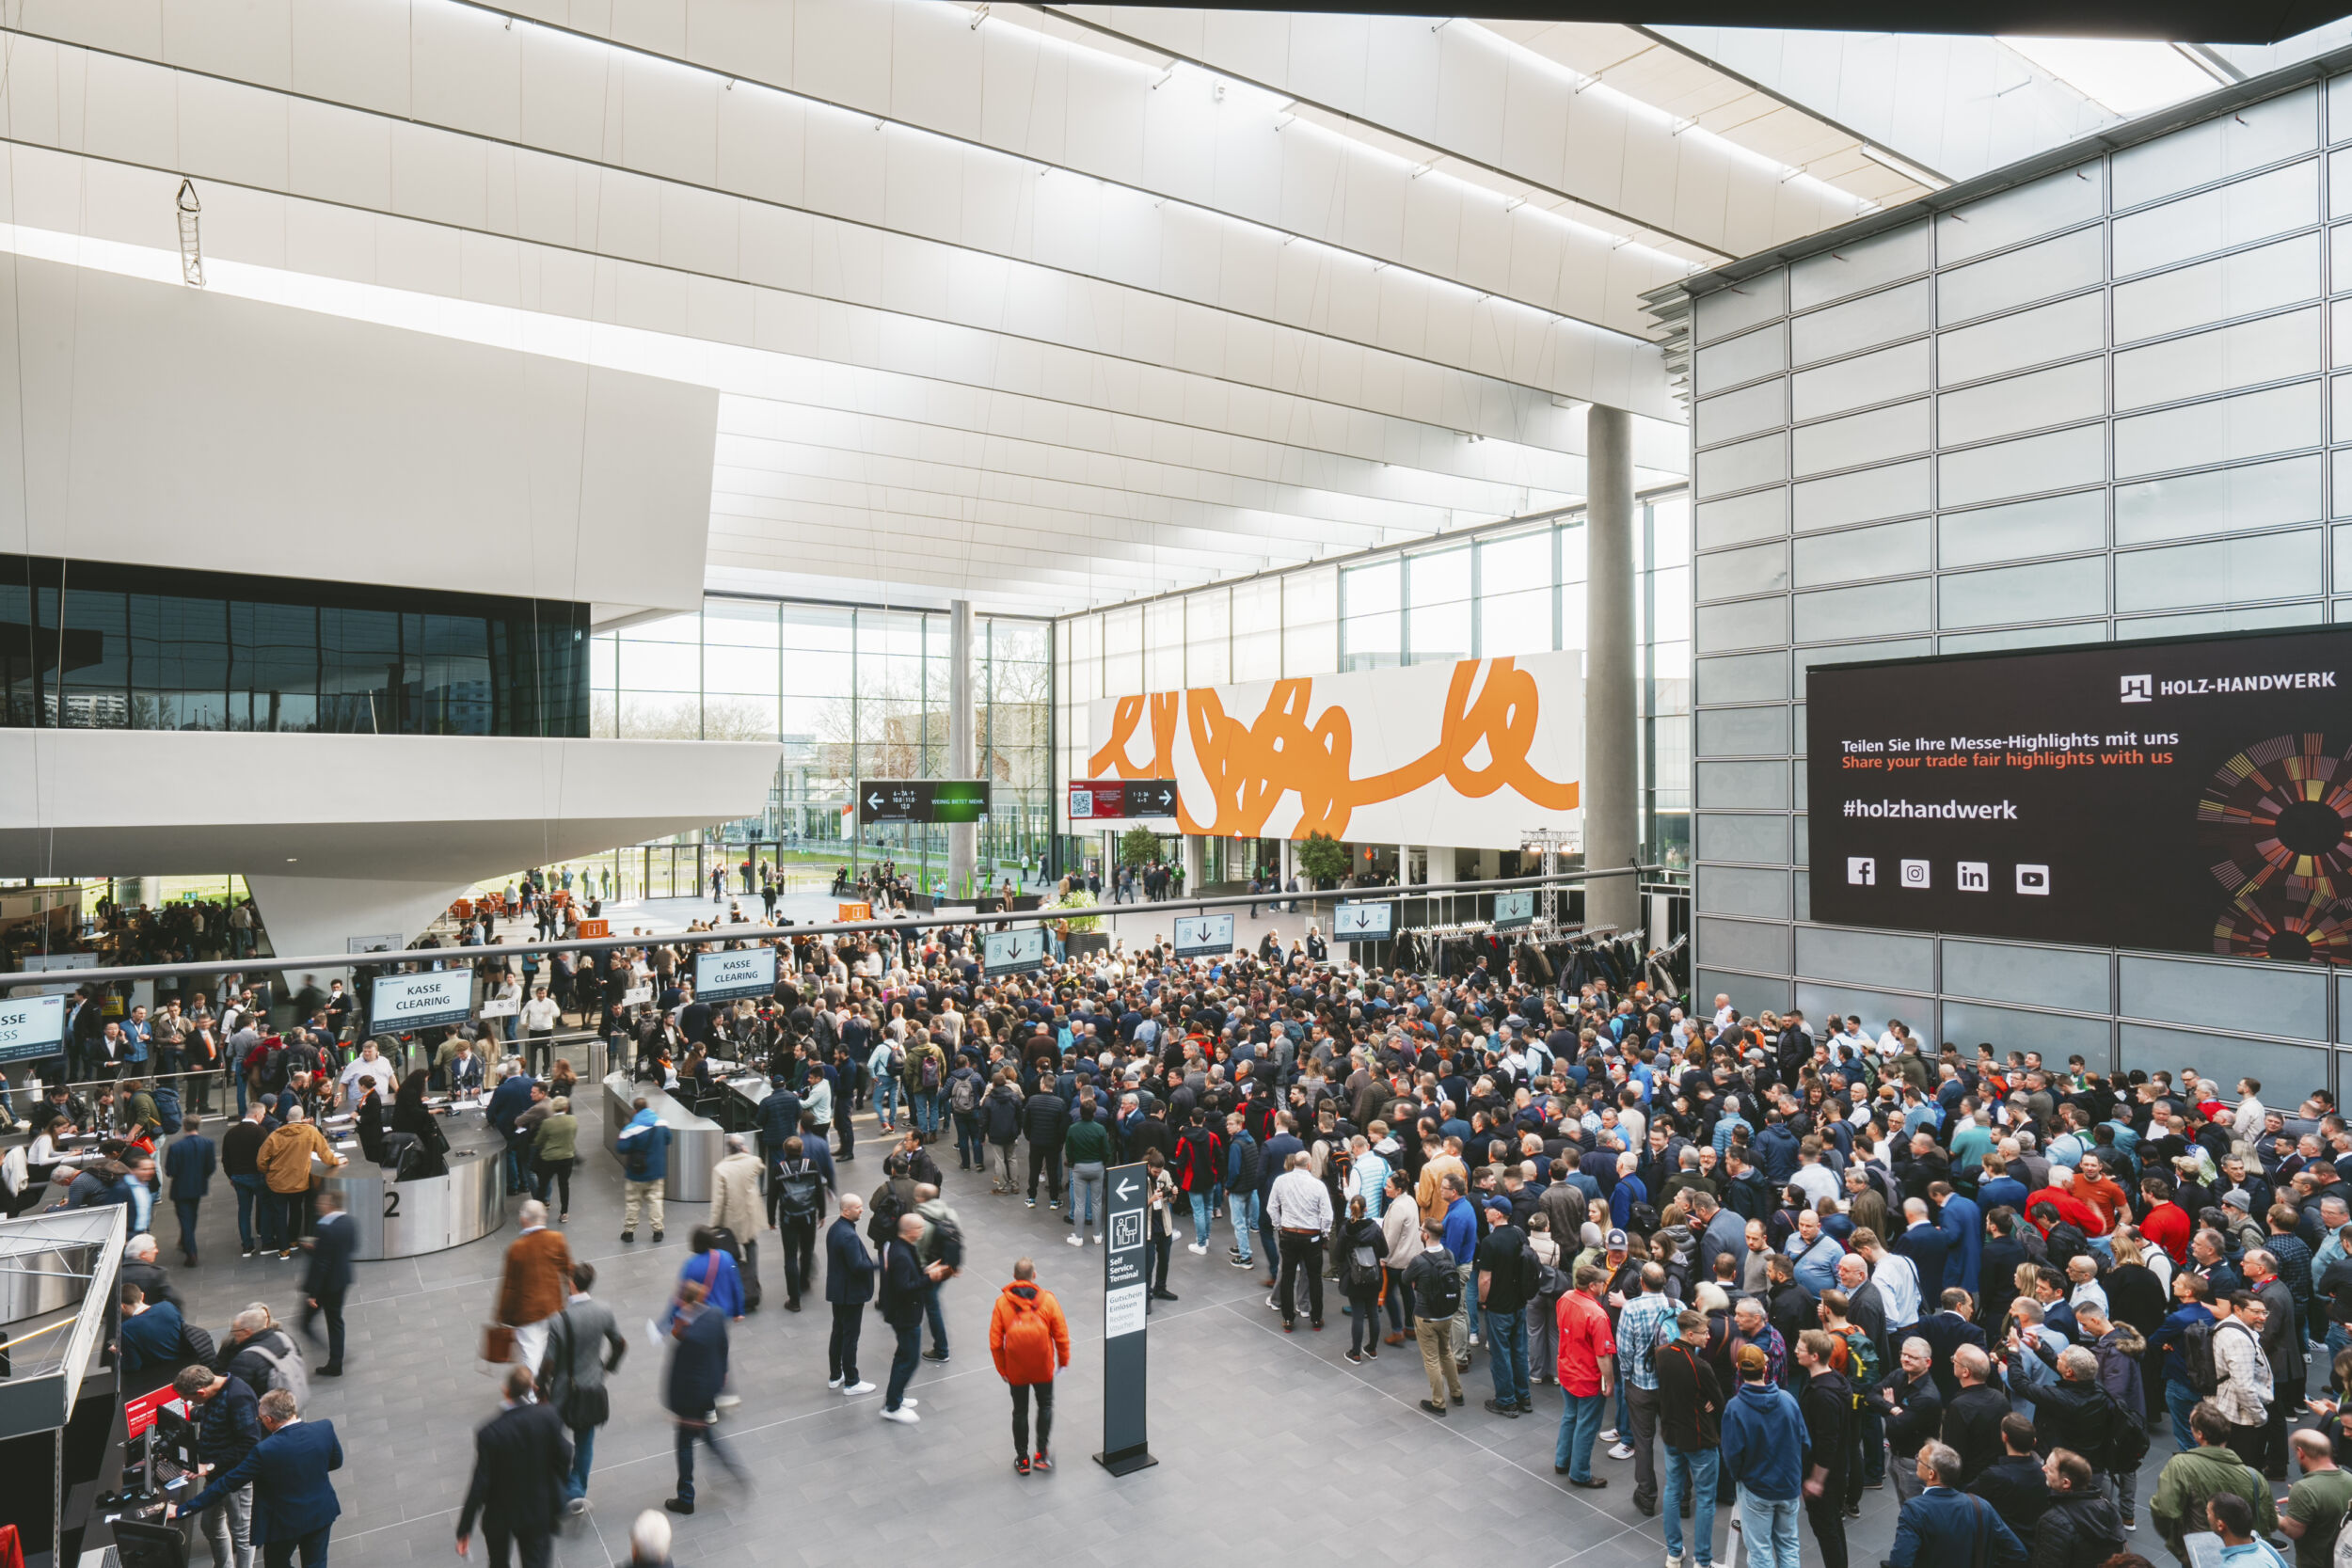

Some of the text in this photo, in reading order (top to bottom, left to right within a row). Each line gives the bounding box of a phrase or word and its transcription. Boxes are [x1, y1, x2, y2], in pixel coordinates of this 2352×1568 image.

[2161, 672, 2337, 695] HOLZ-HANDWERK
[1842, 732, 2179, 752] Teilen Sie Ihre Messe-Highlights mit uns
[1842, 750, 2173, 771] Share your trade fair highlights with us
[1843, 800, 2018, 819] #holzhandwerk
[723, 960, 751, 970] KASSE
[715, 971, 758, 983] CLEARING
[407, 984, 441, 995] KASSE
[396, 996, 451, 1010] CLEARING
[385, 1192, 399, 1217] 2
[1110, 1257, 1122, 1266] Self
[1110, 1263, 1134, 1275] Service
[1110, 1270, 1138, 1283] Terminal
[1110, 1291, 1142, 1304] Gutschein
